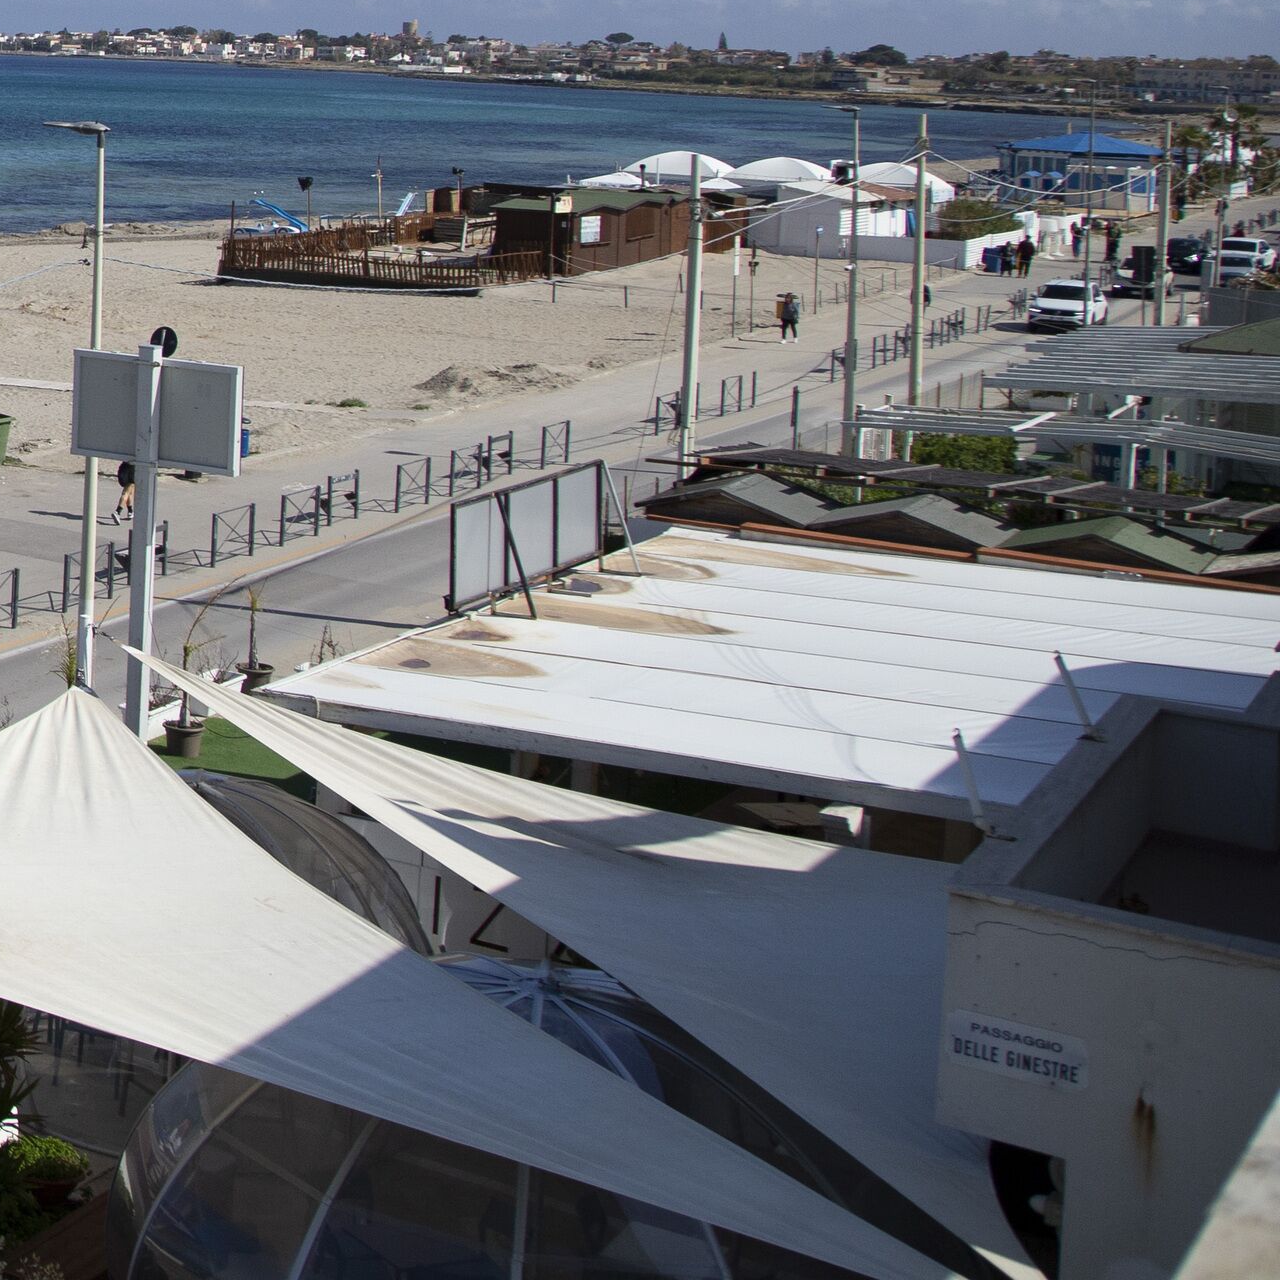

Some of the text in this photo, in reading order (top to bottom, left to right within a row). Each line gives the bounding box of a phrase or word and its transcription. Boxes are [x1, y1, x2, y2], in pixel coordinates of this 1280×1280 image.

[970, 1022, 1063, 1053] PASSAGGIO
[953, 1037, 1078, 1084] DELLE GINESTRE
